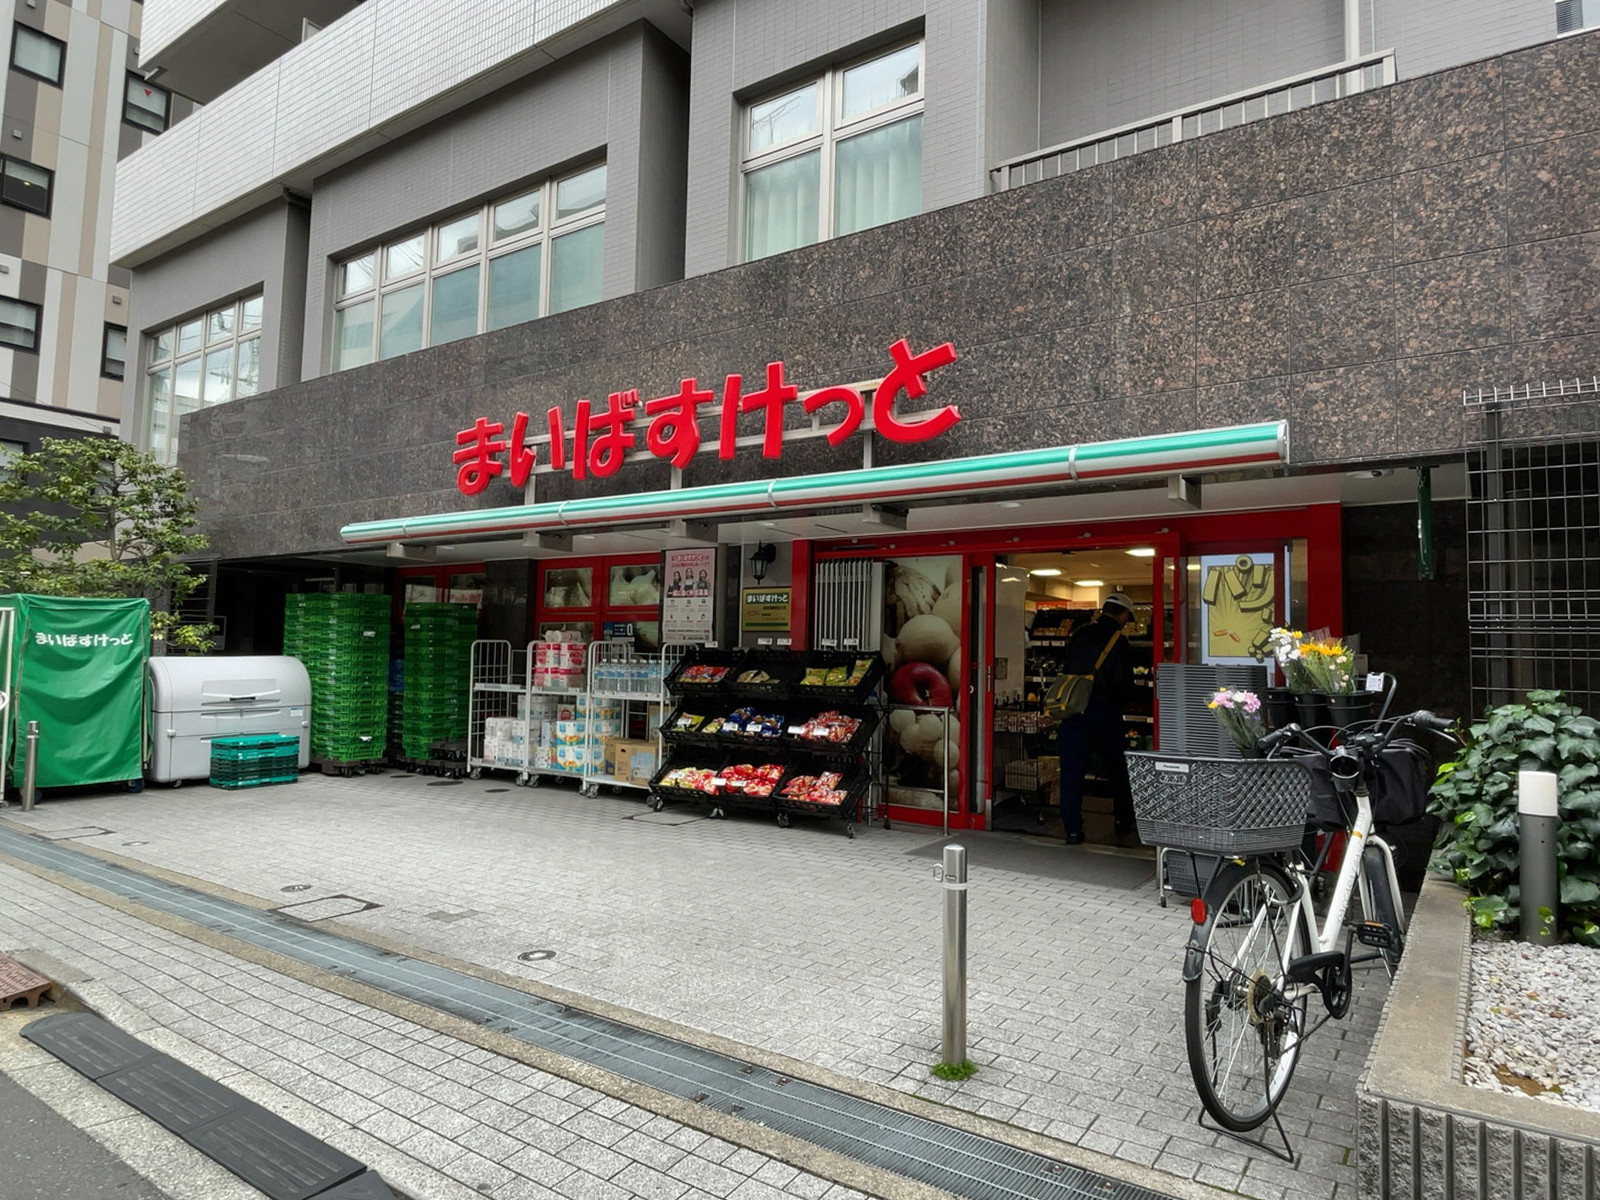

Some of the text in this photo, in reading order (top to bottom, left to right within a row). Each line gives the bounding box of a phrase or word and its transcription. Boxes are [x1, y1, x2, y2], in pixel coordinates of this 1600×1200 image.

[453, 338, 963, 495] まいばすけっと
[35, 632, 133, 647] まいばすけっと
